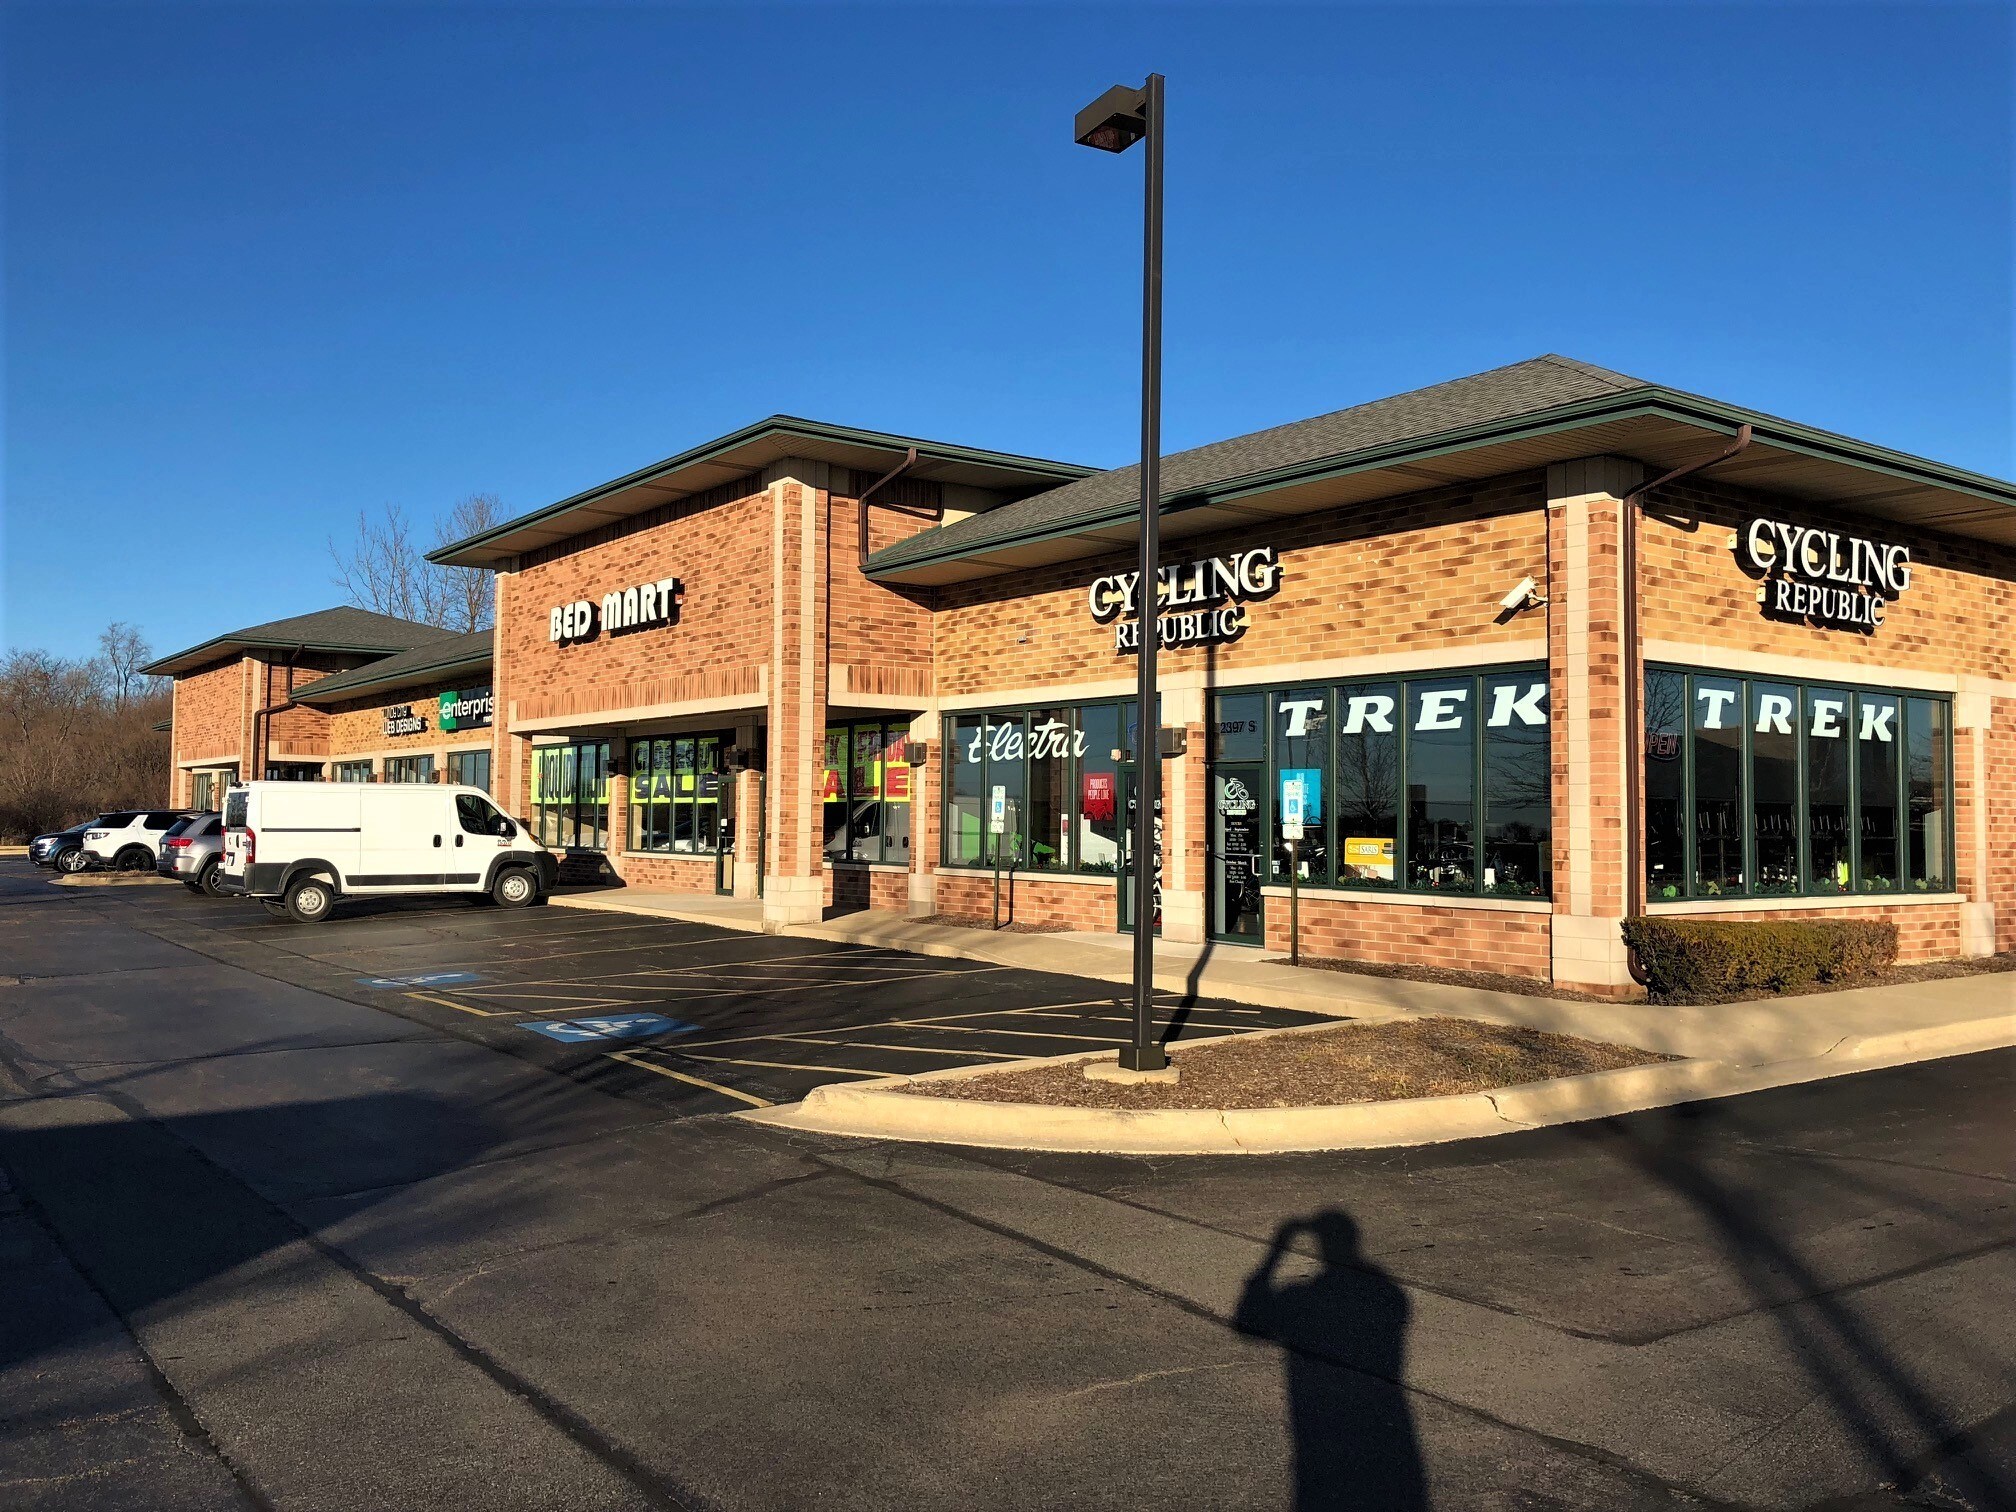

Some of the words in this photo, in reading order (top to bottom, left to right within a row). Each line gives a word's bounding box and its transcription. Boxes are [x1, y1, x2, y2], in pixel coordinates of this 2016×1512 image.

[1749, 518, 1912, 591] CYCLING
[549, 600, 592, 642] BED
[601, 577, 674, 631] MART
[1775, 579, 1886, 626] REPUBLIC
[1114, 606, 1239, 649] REUBLIC
[396, 717, 421, 732] DESIGNS
[441, 692, 494, 720] enterpris
[1220, 721, 1245, 734] 2397
[1248, 720, 1256, 732] S
[1278, 683, 1547, 737] TREK
[1697, 688, 1895, 742] TREK
[968, 717, 1091, 763] Electra
[635, 774, 718, 799] SALE
[824, 767, 909, 798] ALE
